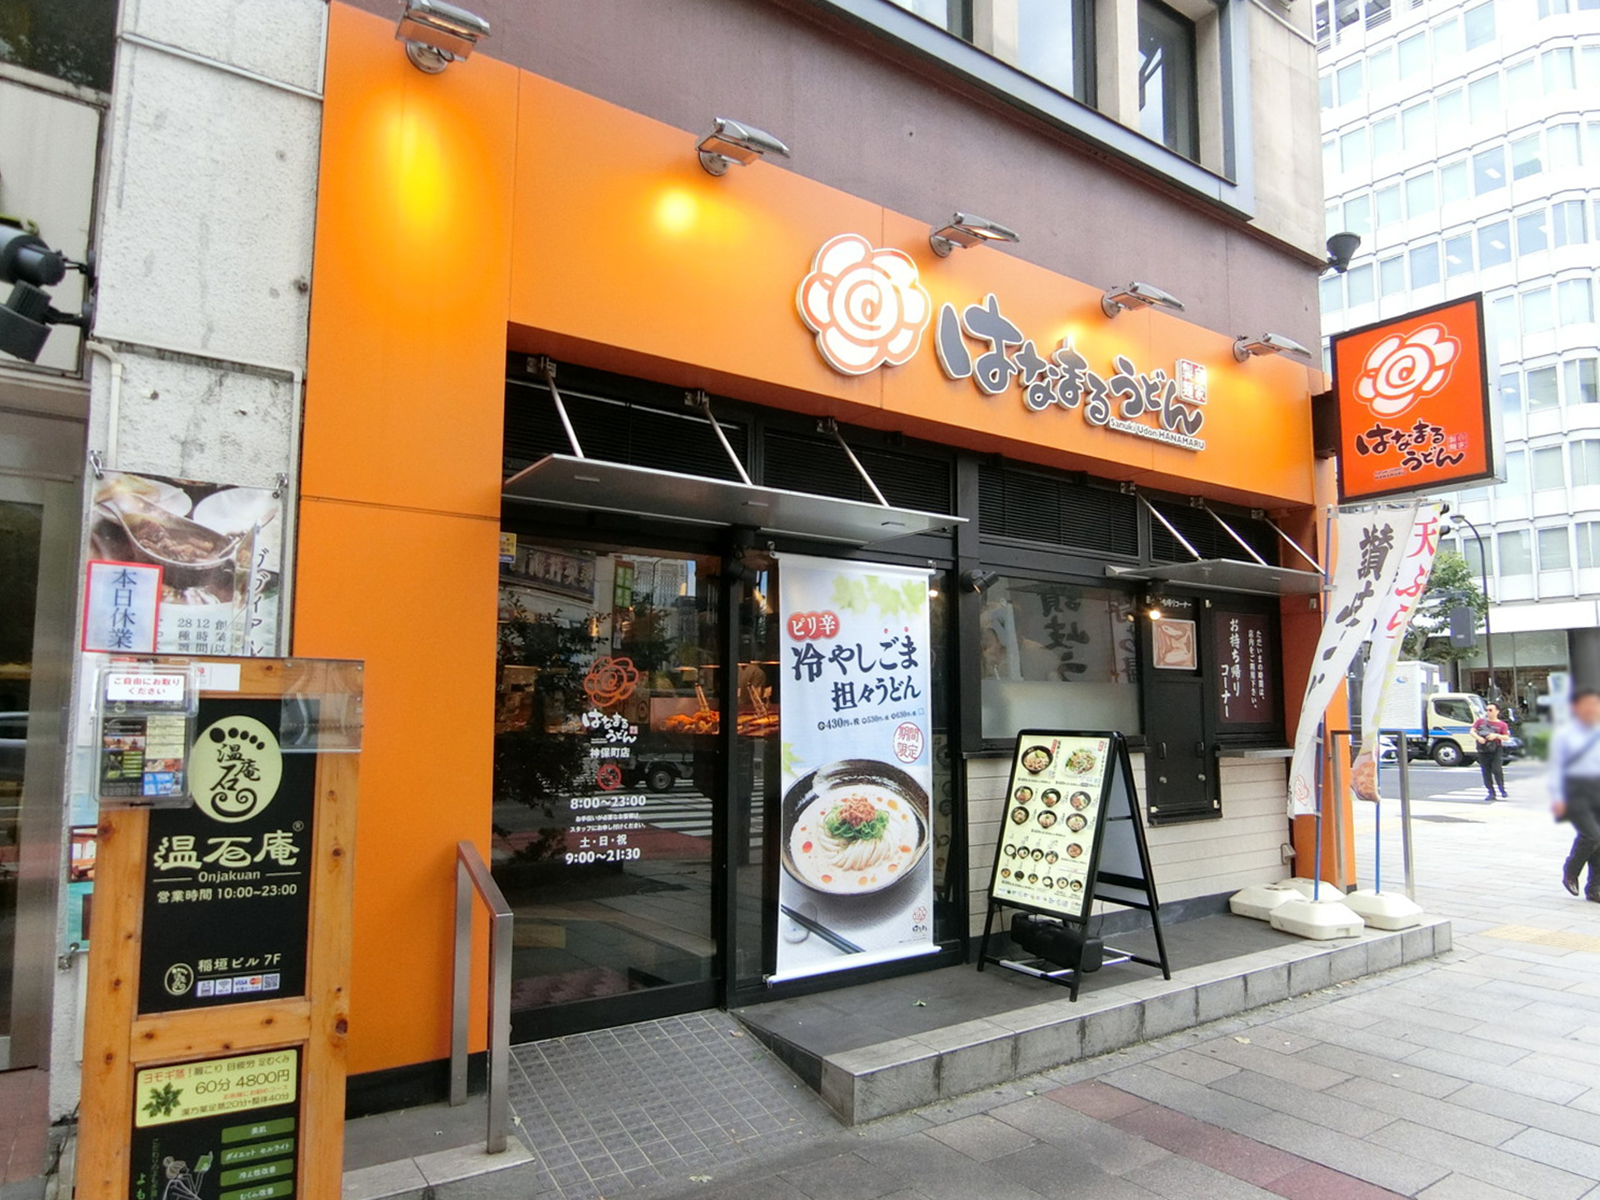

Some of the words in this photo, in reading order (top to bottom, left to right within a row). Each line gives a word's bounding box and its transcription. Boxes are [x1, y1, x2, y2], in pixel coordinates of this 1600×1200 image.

[934, 294, 1204, 436] はなまるうどん
[1158, 430, 1205, 449] HANAMARU
[1356, 418, 1444, 455] はなまる
[1402, 447, 1464, 471] うどん
[108, 569, 136, 649] 本日休業
[791, 614, 836, 636] ピリ辛
[791, 635, 918, 682] 冷やしごま
[1229, 618, 1242, 697] お持ち帰り
[114, 677, 180, 686] ご自由にお取り
[128, 687, 166, 696] ください
[1221, 664, 1231, 717] コーナー
[831, 675, 921, 712] 担々うどん
[581, 709, 629, 730] はなまる
[605, 730, 637, 743] うどん
[590, 747, 630, 759] 神保町店
[153, 829, 300, 871] 温石庵
[198, 871, 261, 884] Onjakuan
[157, 888, 212, 904] 営業時間
[198, 957, 259, 972] 稲垣ビル
[264, 953, 281, 966] 7F
[195, 1078, 230, 1095] 60分
[236, 1069, 289, 1088] 4800円
[239, 1166, 276, 1179] 冷え性改善
